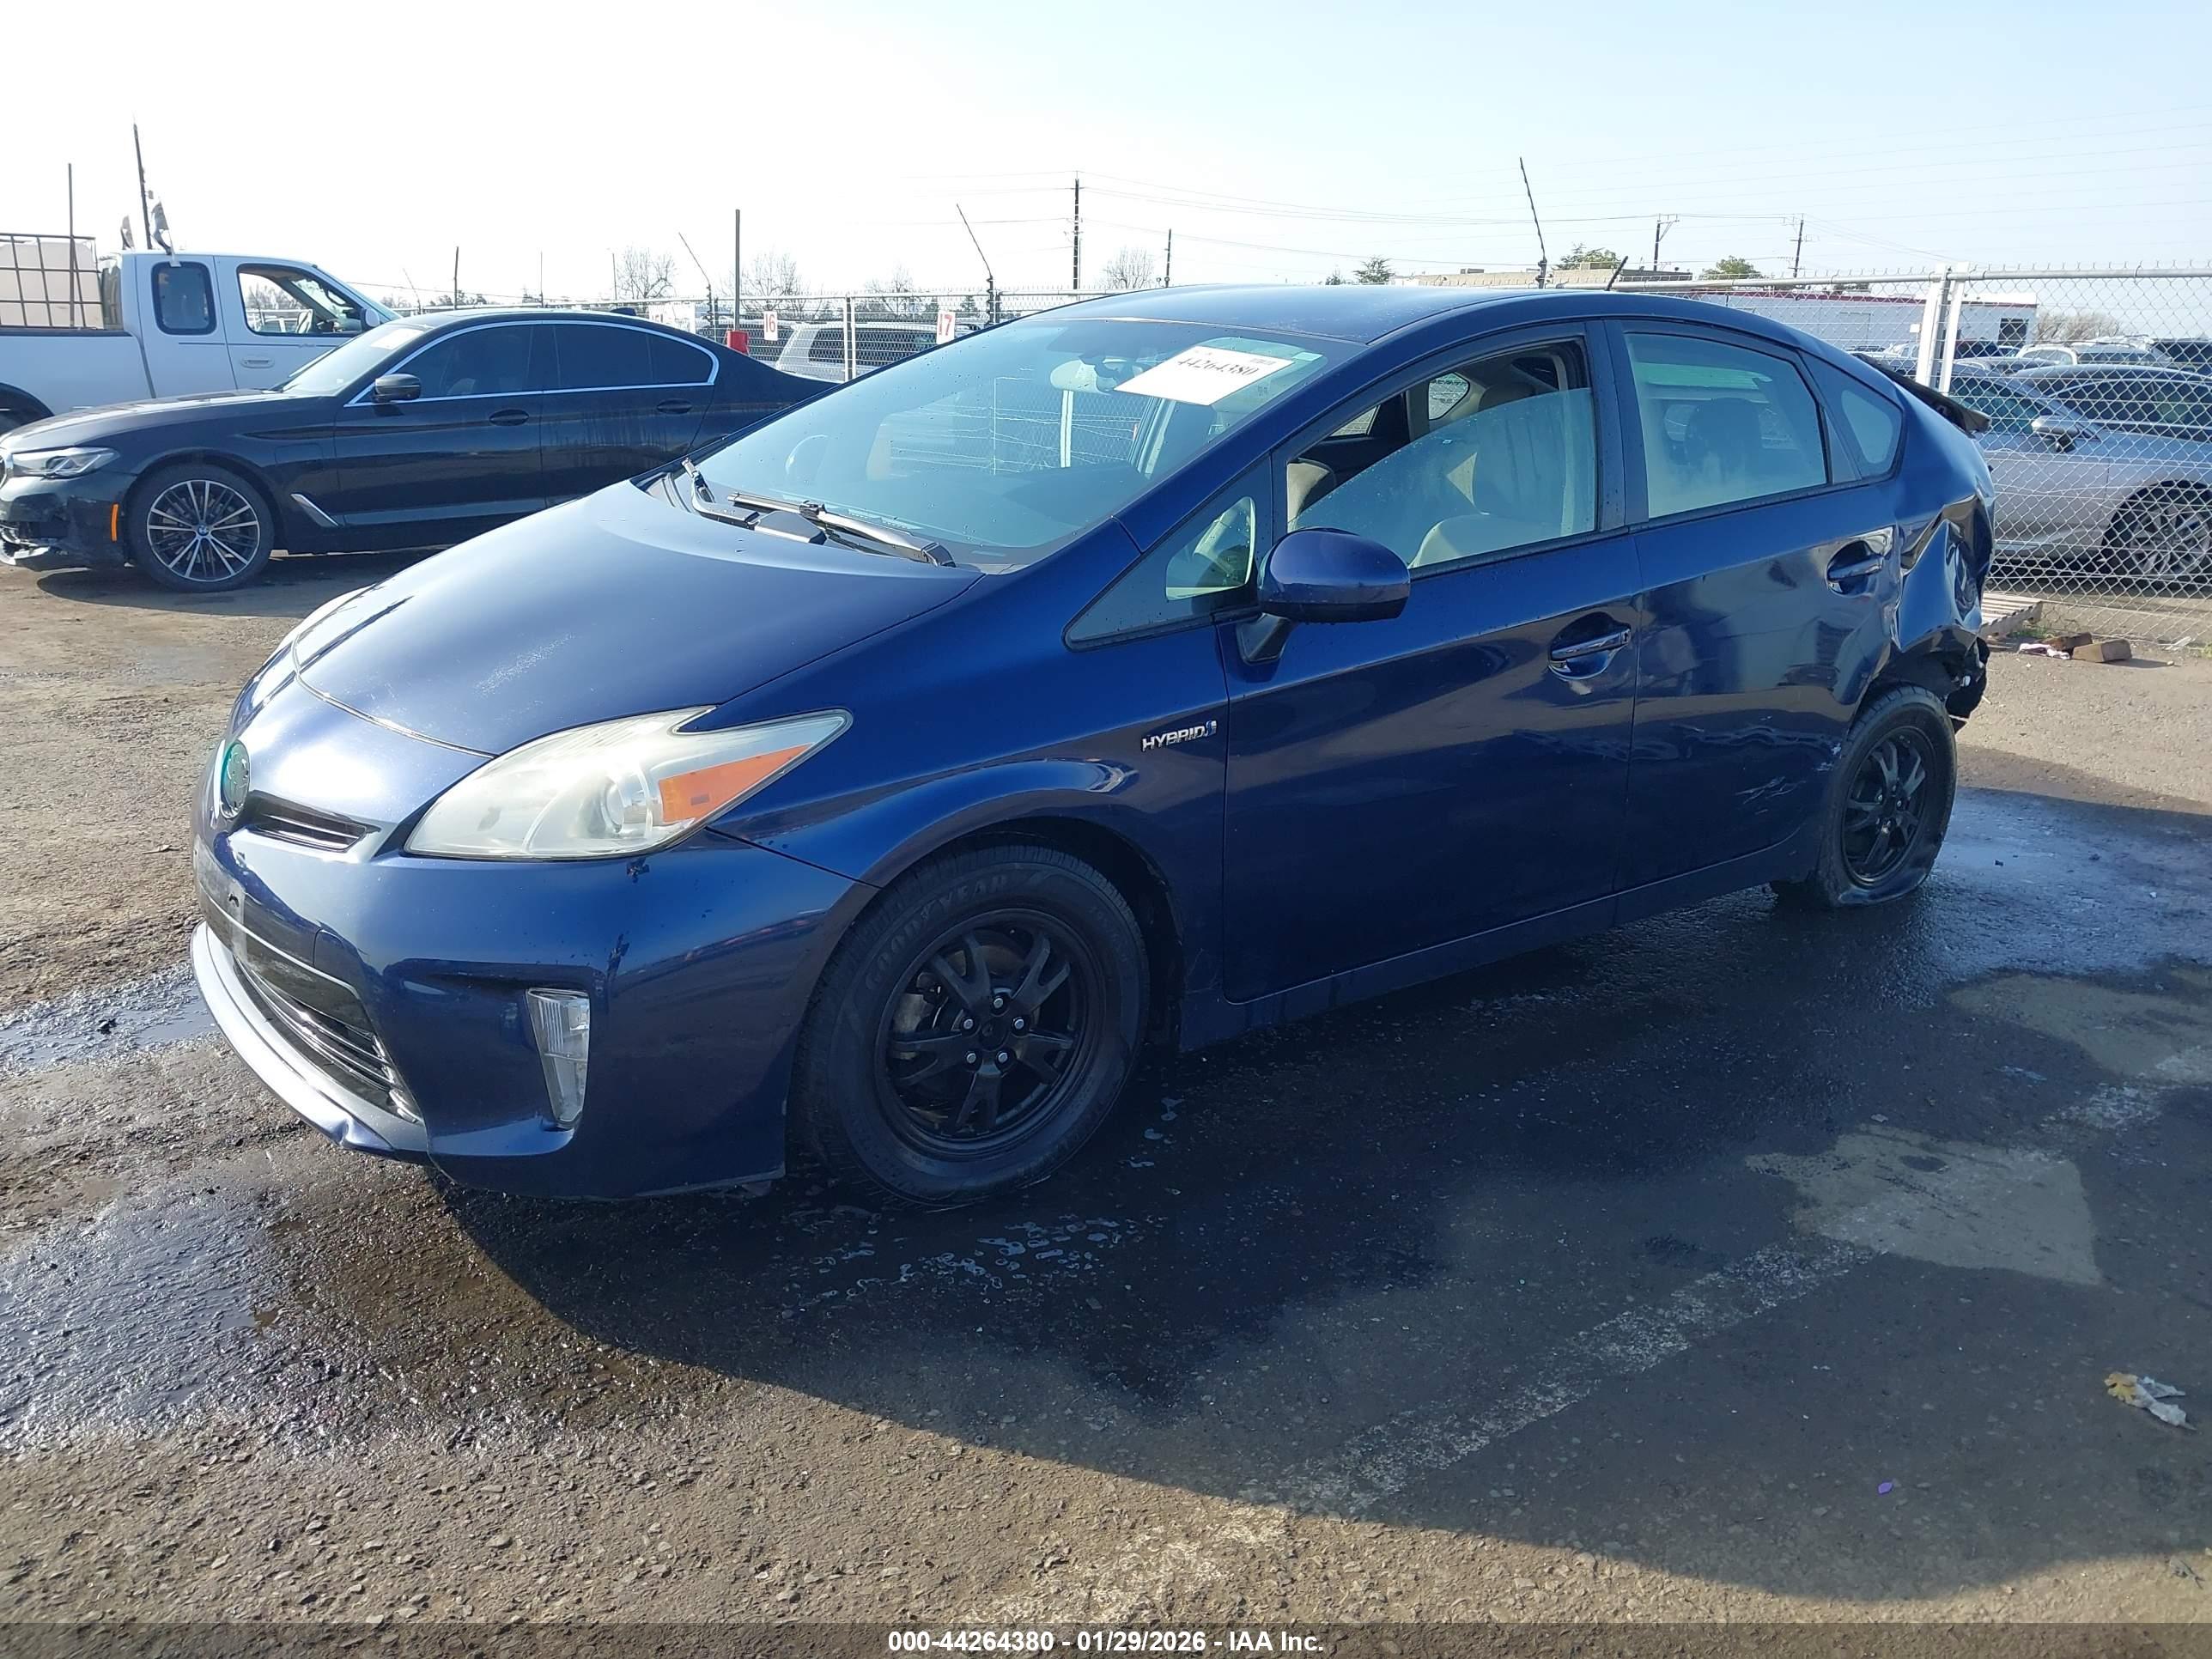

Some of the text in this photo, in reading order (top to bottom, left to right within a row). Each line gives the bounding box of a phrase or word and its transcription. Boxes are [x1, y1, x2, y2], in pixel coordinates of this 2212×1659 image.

[765, 313, 776, 333] 16
[939, 313, 953, 336] 17
[1177, 357, 1260, 376] 44264380
[1141, 725, 1206, 752] HYBRID
[864, 872, 1008, 991] GOODYEAR
